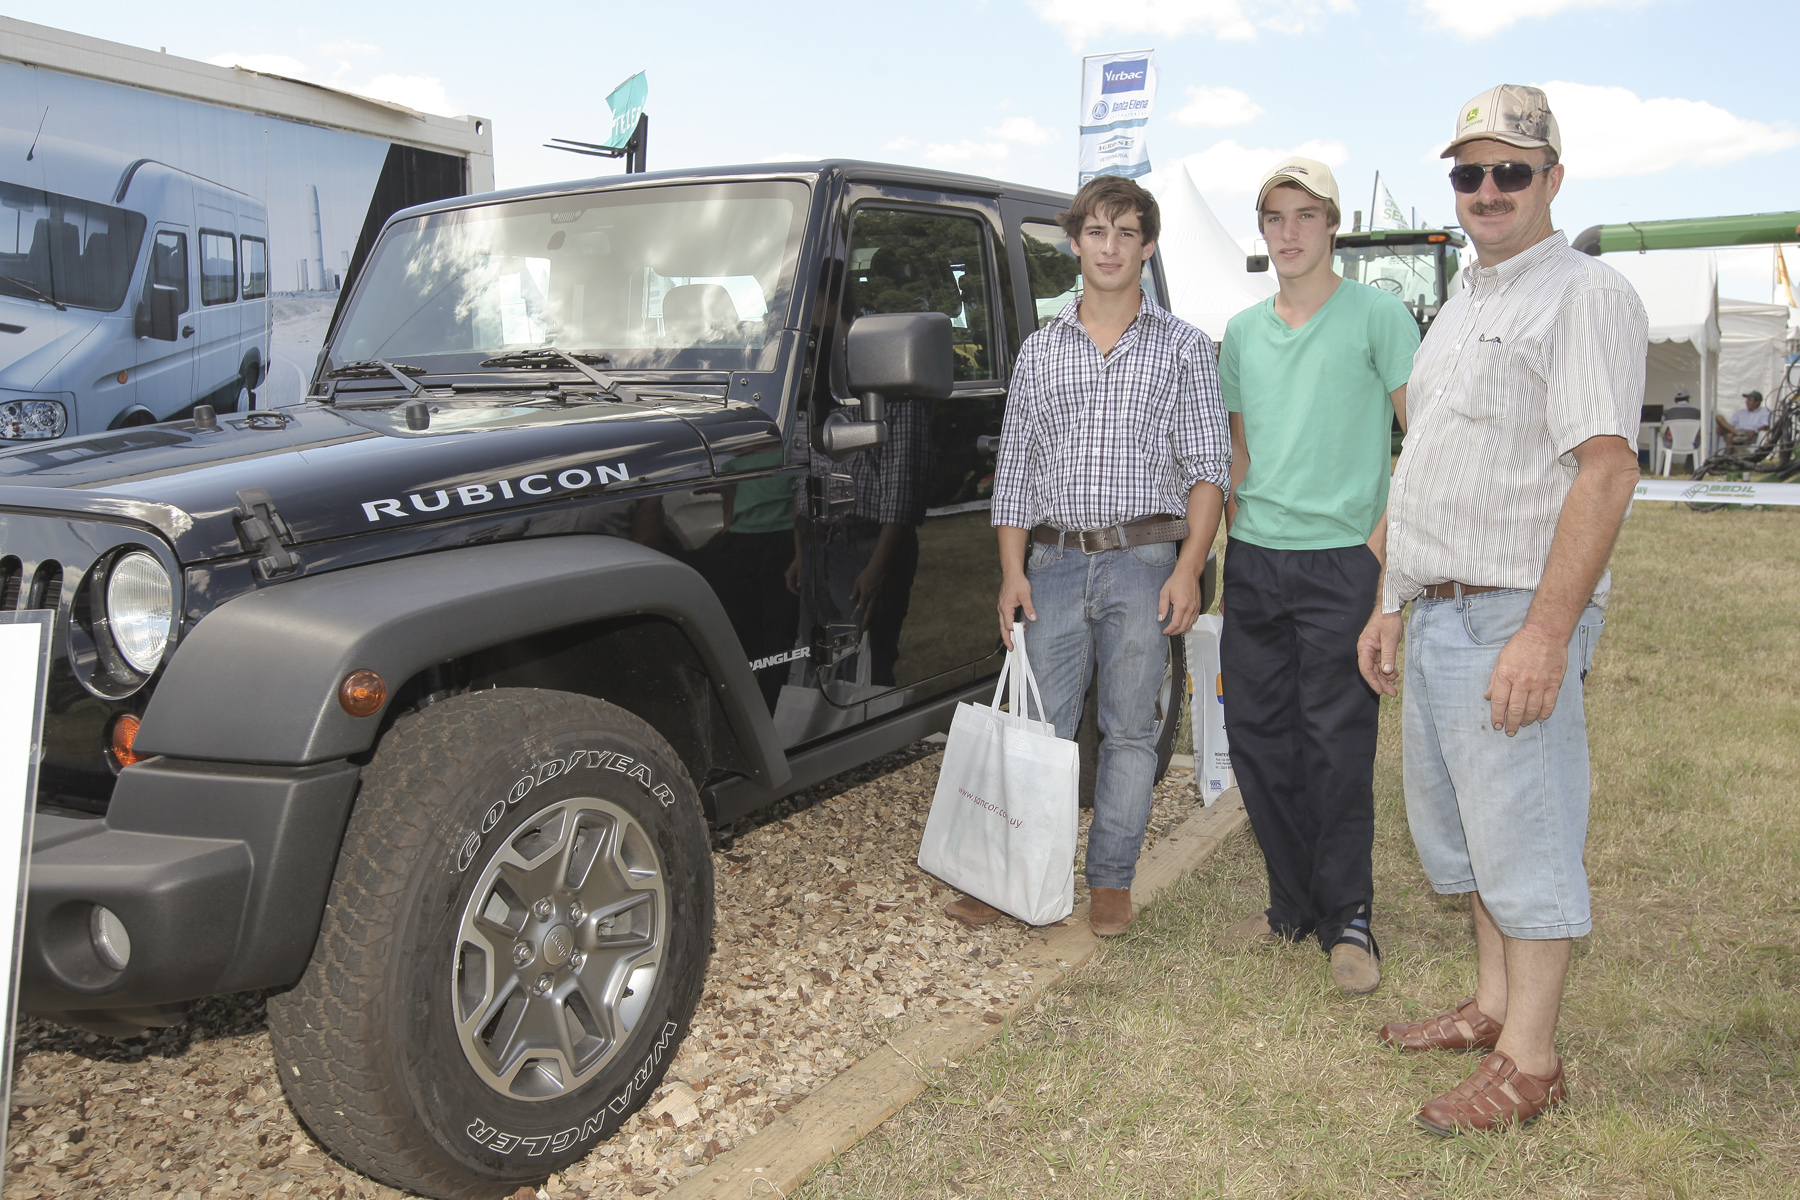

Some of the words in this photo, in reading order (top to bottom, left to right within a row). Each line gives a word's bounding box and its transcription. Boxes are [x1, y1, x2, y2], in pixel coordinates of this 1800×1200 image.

[1105, 70, 1144, 80] Virbac
[1129, 100, 1148, 110] Elena
[361, 462, 630, 522] RUBICON
[458, 750, 676, 872] GOODYEAR
[466, 1021, 678, 1157] WRANGLER
